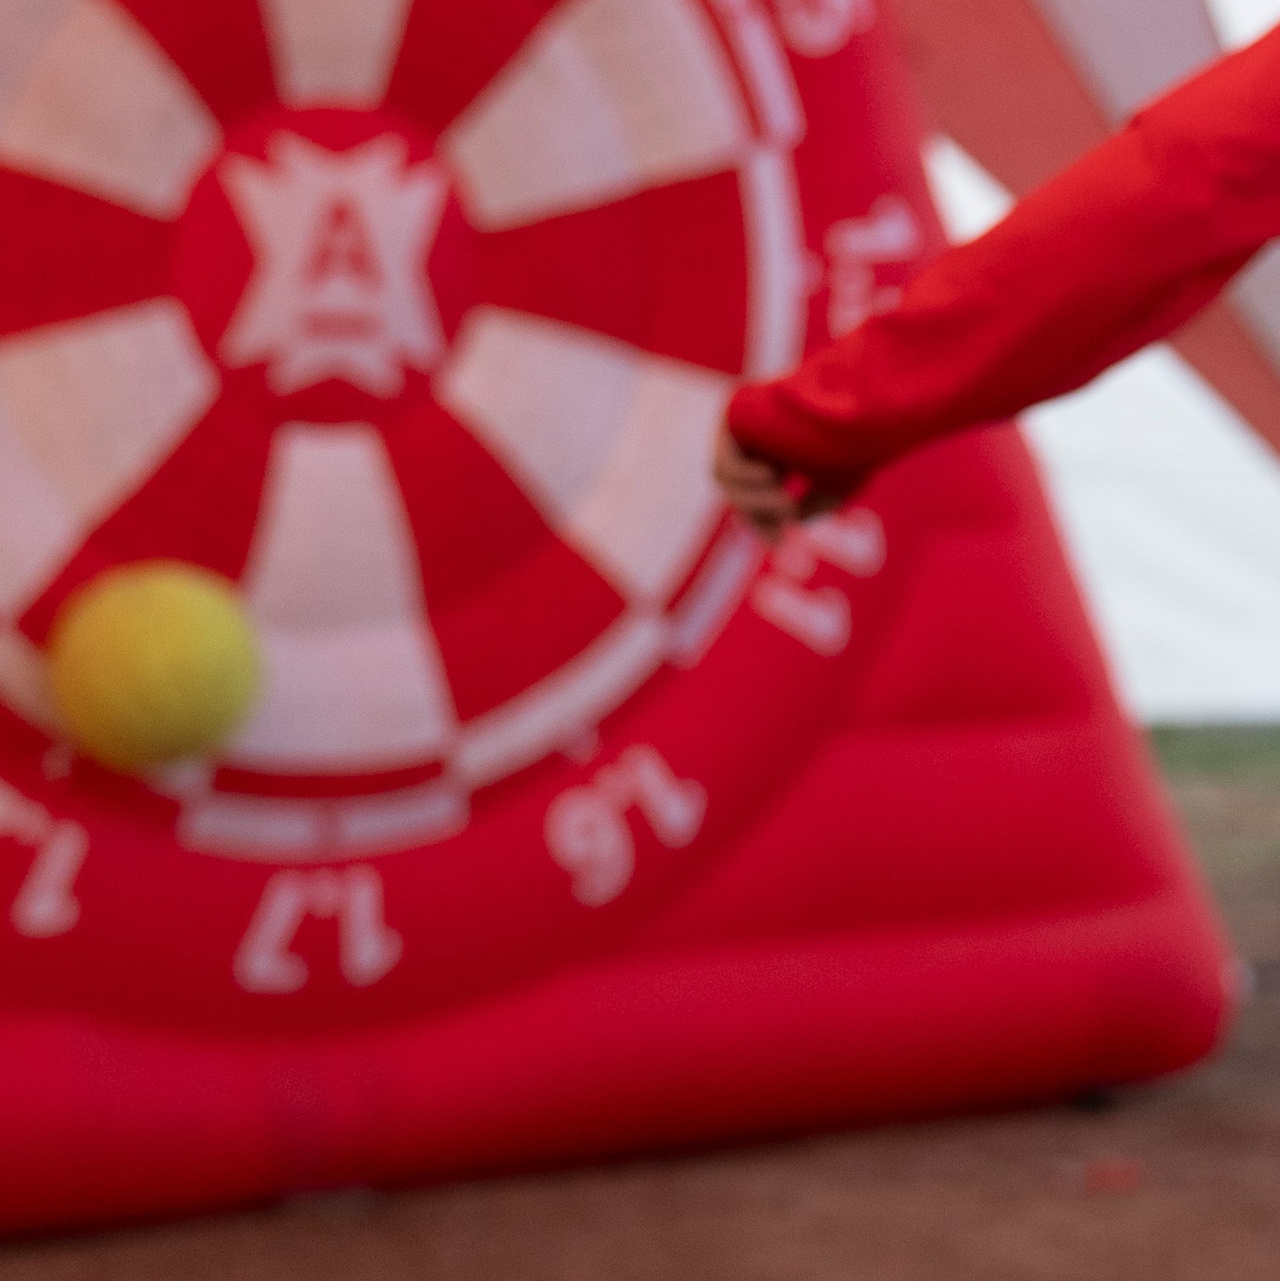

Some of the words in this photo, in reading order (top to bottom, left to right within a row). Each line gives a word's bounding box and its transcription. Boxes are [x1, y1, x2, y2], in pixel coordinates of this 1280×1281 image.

[823, 193, 922, 342] 1
[544, 742, 708, 908] 16
[234, 863, 402, 994] 17
